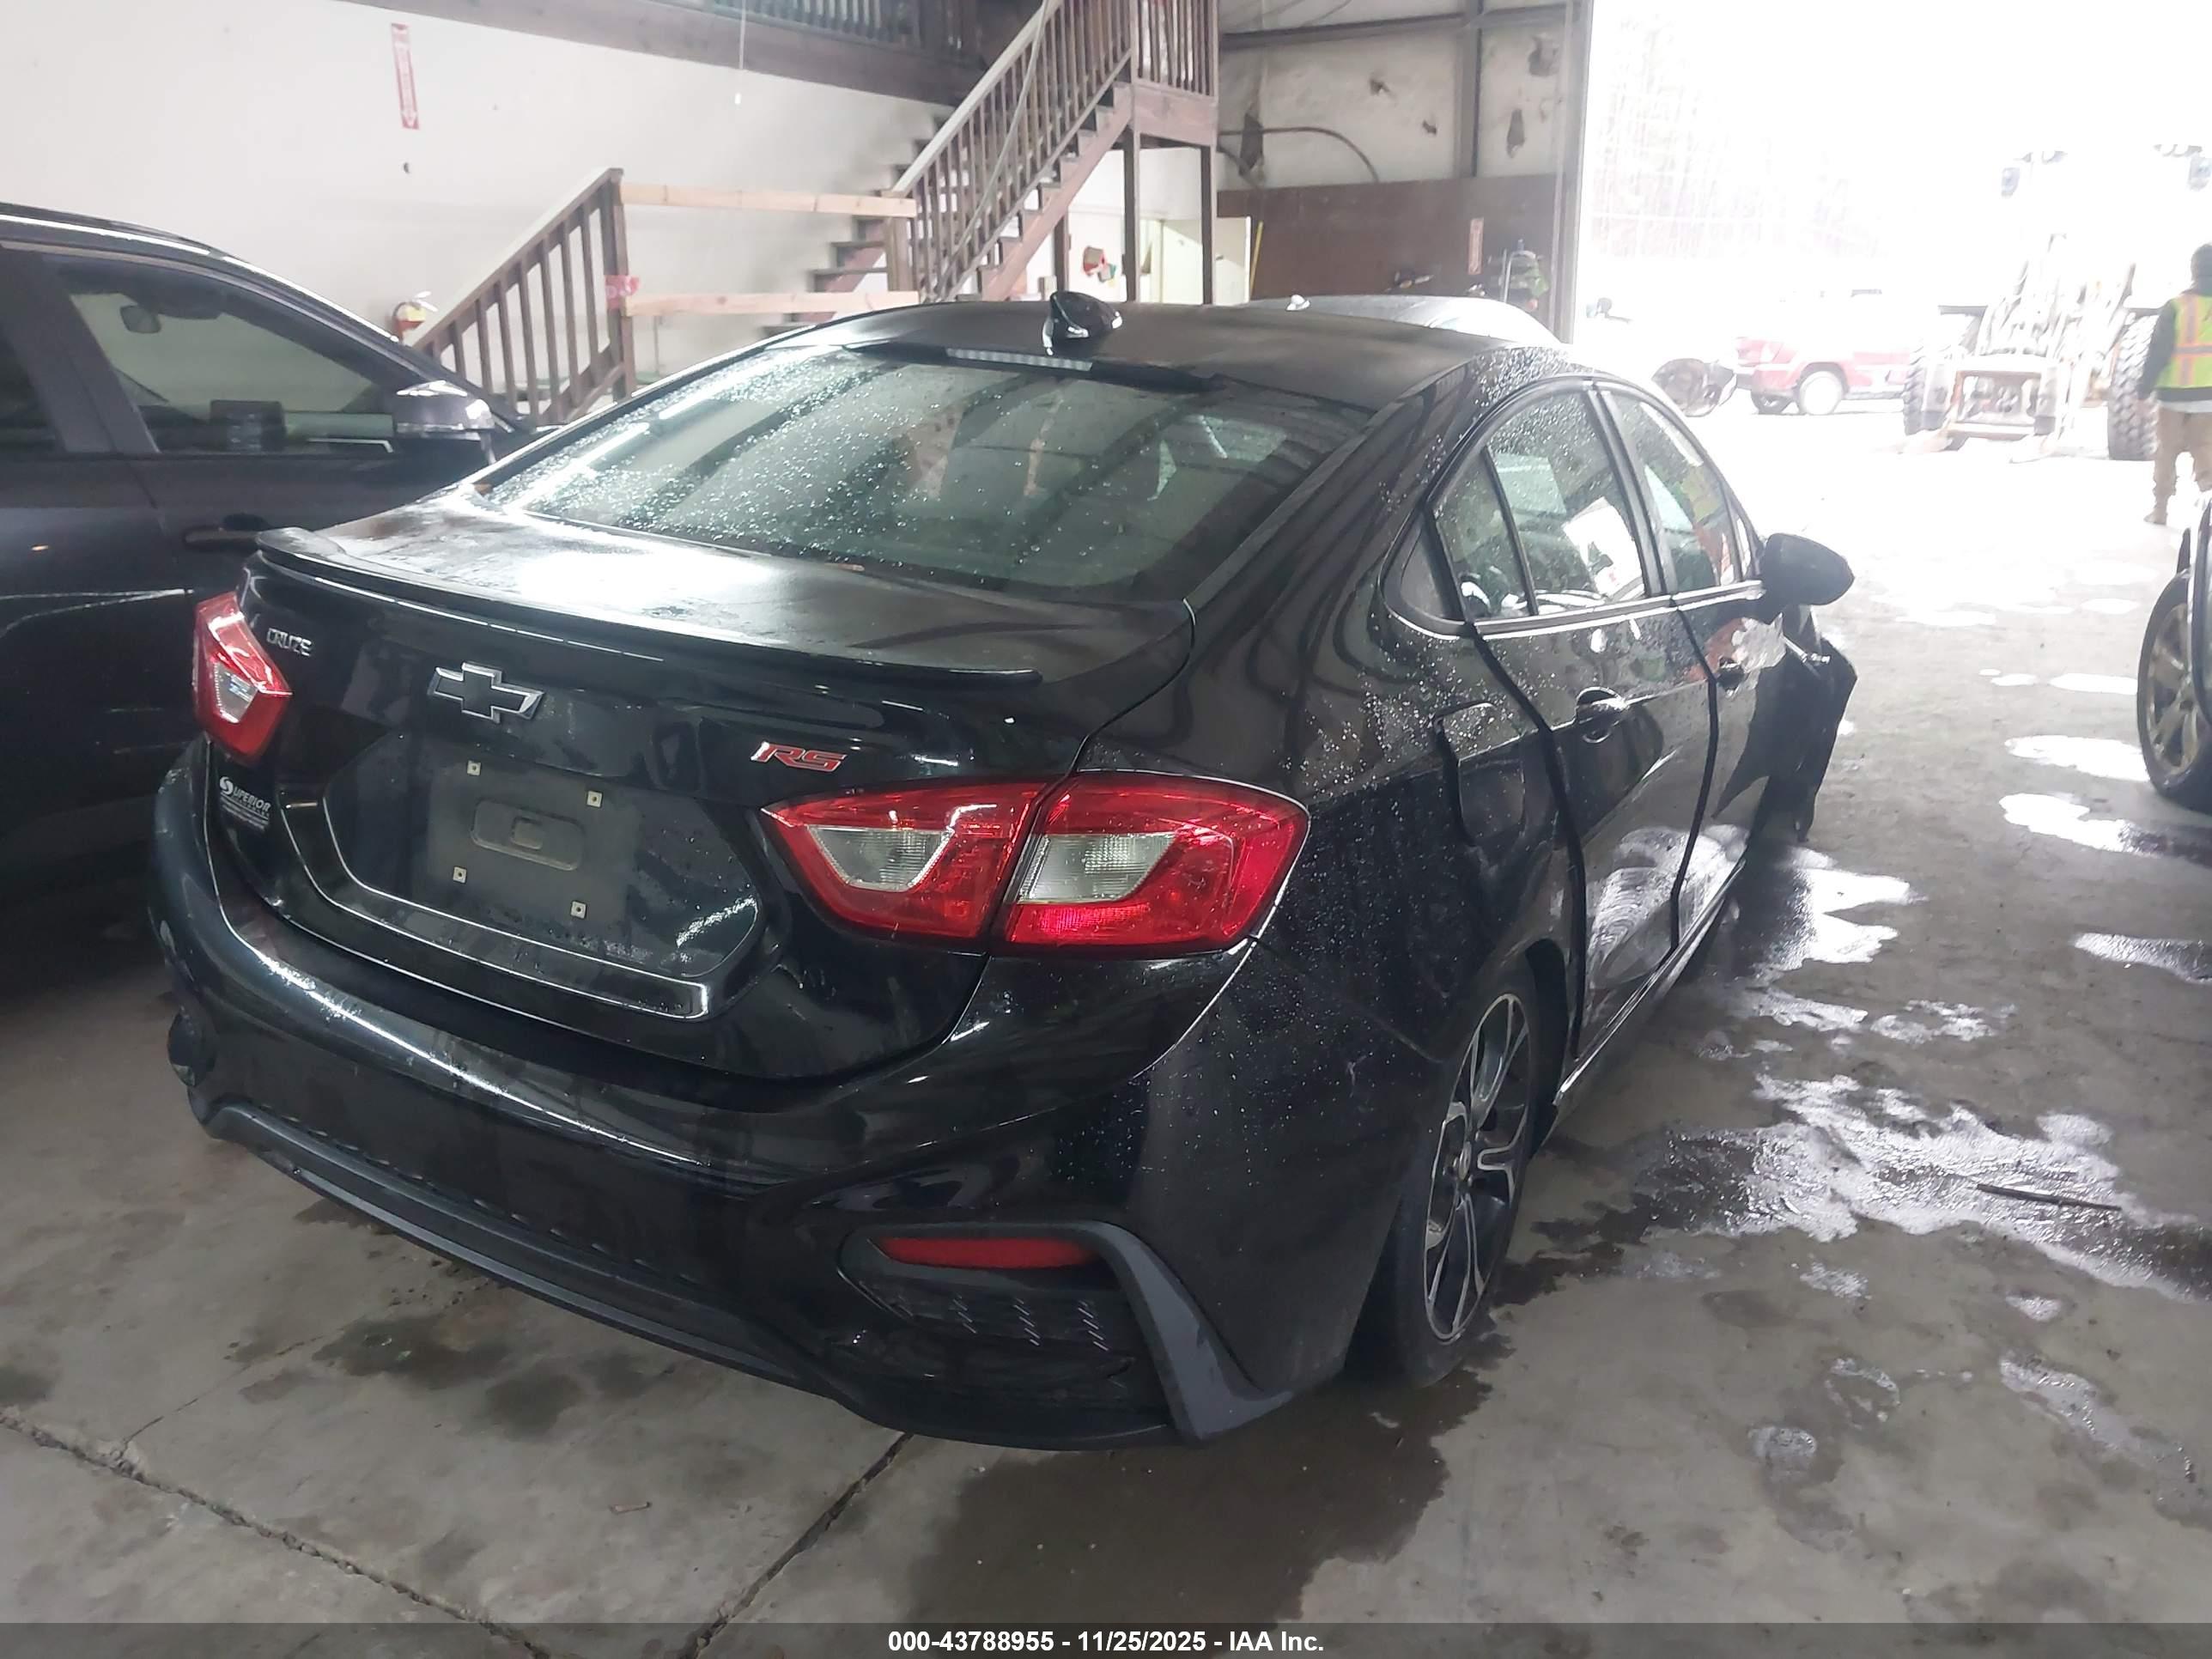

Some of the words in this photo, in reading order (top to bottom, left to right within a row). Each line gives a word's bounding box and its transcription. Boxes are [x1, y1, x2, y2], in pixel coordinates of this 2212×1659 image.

[267, 628, 312, 656] CRUZE
[750, 741, 848, 772] RS
[220, 776, 271, 811] SUPERIOR
